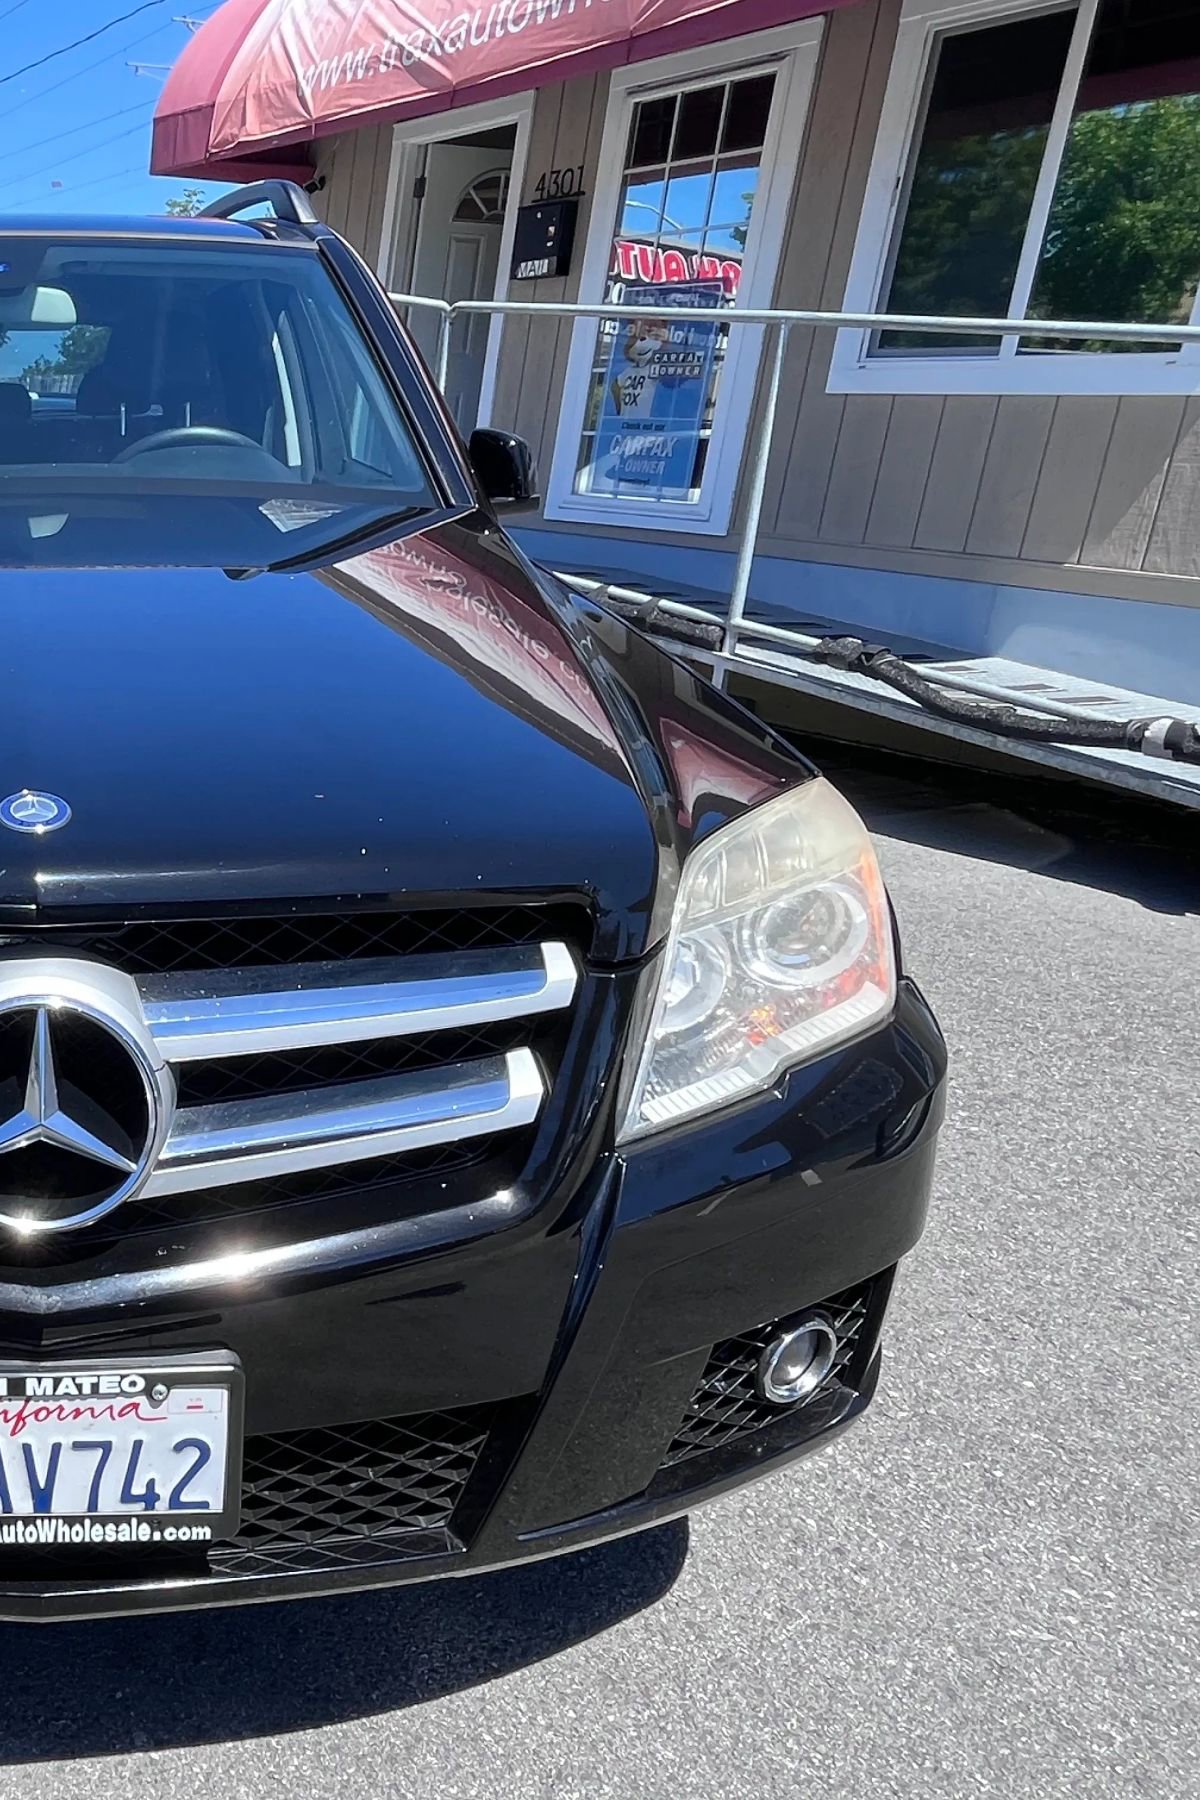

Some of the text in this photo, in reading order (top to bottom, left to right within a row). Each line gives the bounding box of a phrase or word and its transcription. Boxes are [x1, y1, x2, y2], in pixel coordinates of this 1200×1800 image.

[535, 165, 584, 200] 4301
[660, 366, 700, 376] OWNER
[622, 392, 641, 407] OX
[609, 434, 678, 458] CARFAX
[25, 1374, 146, 1396] MATEO
